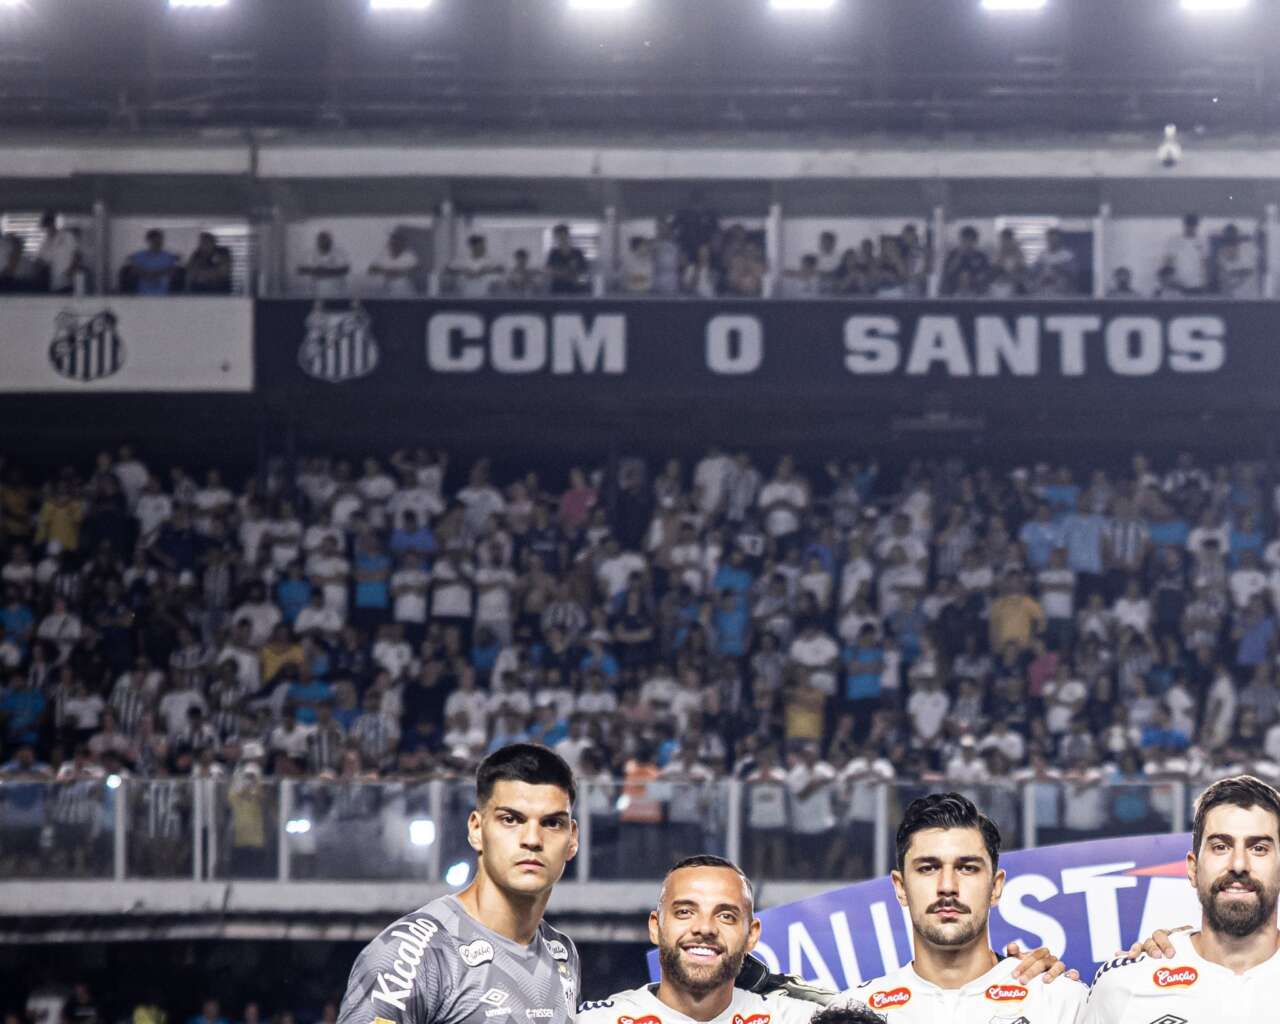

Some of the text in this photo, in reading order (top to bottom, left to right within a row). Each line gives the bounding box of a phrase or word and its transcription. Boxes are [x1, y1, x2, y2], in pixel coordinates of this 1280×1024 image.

[427, 313, 627, 374] COM
[705, 313, 764, 375] O
[843, 313, 1227, 376] SANTOS
[371, 917, 438, 1011] Kicaldo
